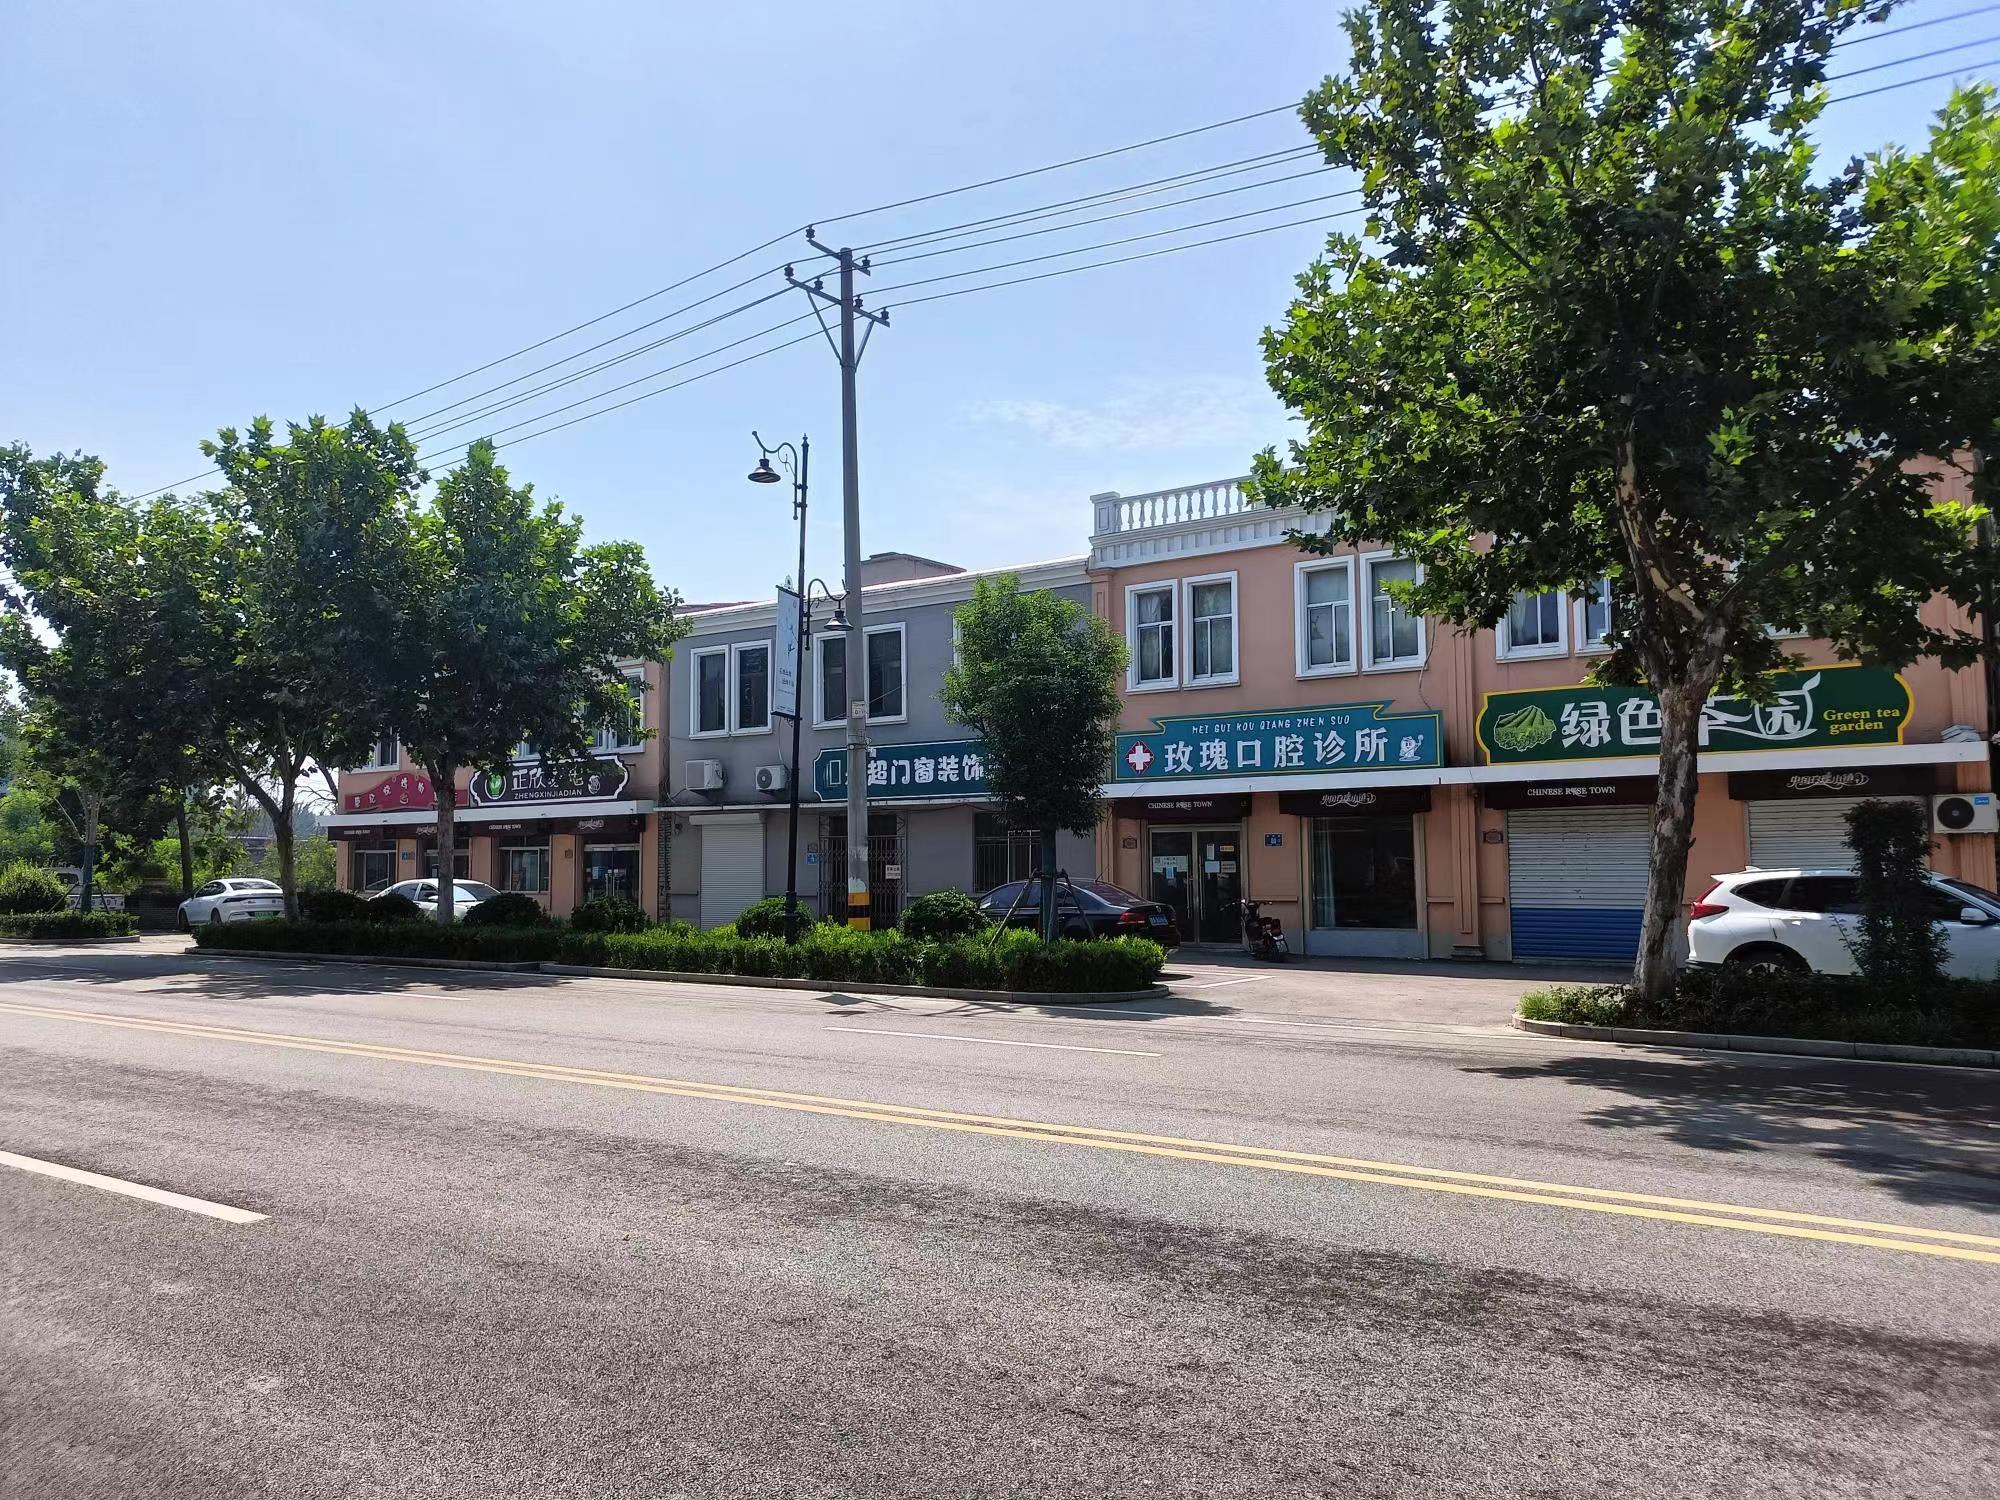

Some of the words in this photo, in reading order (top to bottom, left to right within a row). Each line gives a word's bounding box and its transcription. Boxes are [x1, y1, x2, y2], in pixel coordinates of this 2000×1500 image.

[1823, 708, 1870, 722] Green
[1876, 706, 1901, 719] tea
[1214, 723, 1231, 733] GUI
[1236, 721, 1255, 731] KOU
[1260, 719, 1291, 730] QIANG
[1330, 715, 1349, 725] SUO
[1829, 719, 1884, 733] garden
[1165, 727, 1388, 774] 玫瑰口腔诊所
[845, 753, 1003, 786] 超门窗装饰
[514, 789, 583, 800] ZHENGXINJIADIAN
[1527, 788, 1563, 796] CHINESE
[1590, 786, 1616, 794] TOWN
